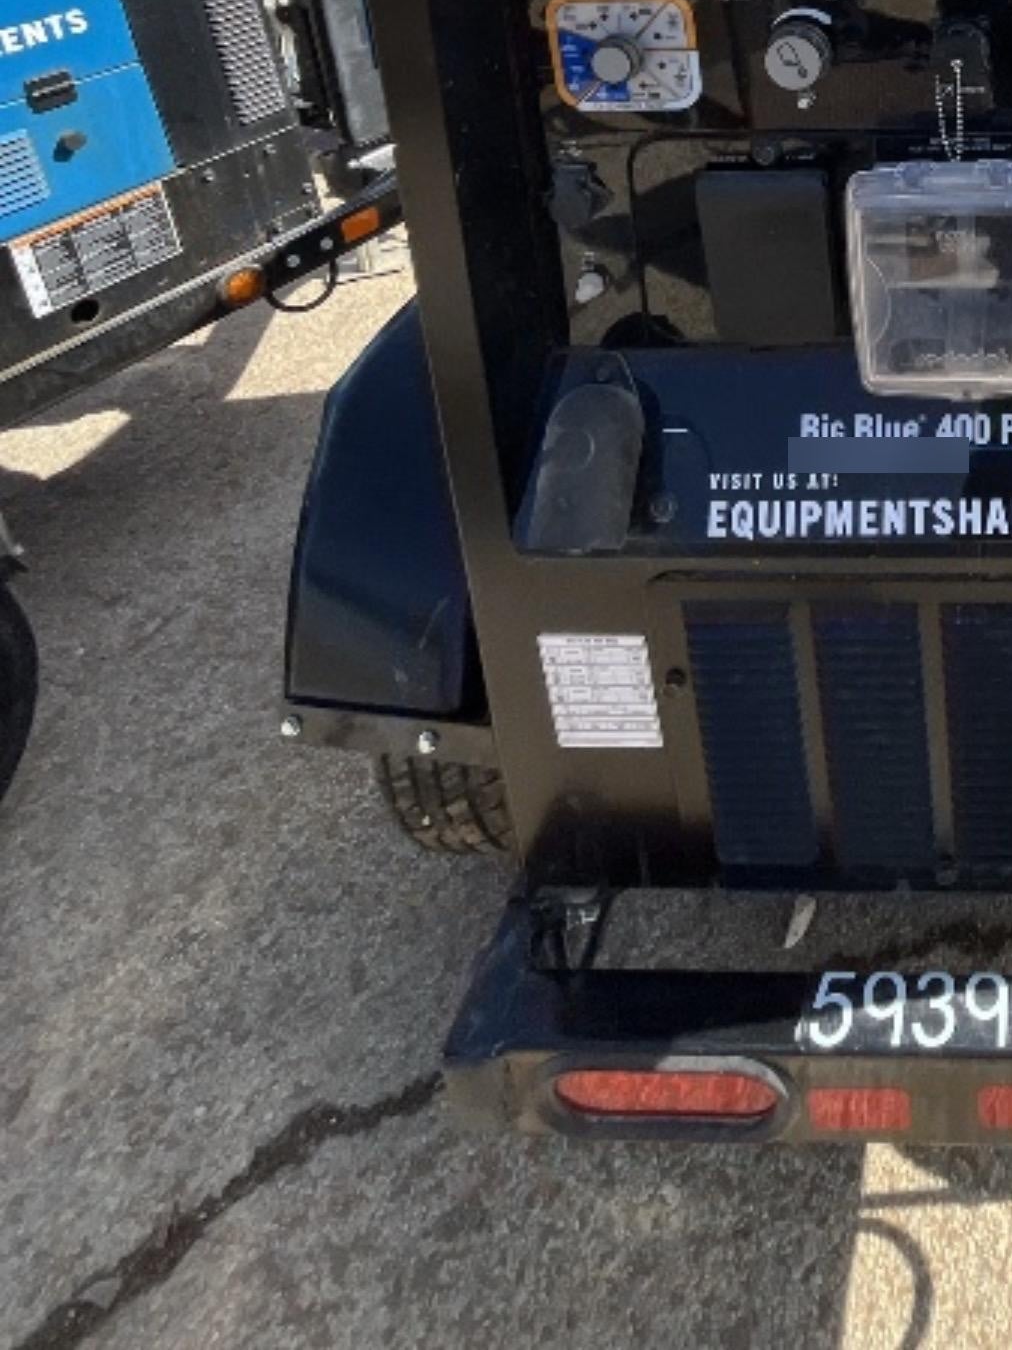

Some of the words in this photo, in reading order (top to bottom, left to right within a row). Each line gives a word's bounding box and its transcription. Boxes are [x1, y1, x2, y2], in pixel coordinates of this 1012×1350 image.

[935, 413, 991, 445] 400
[709, 472, 763, 491] VISIT
[773, 472, 798, 491] US
